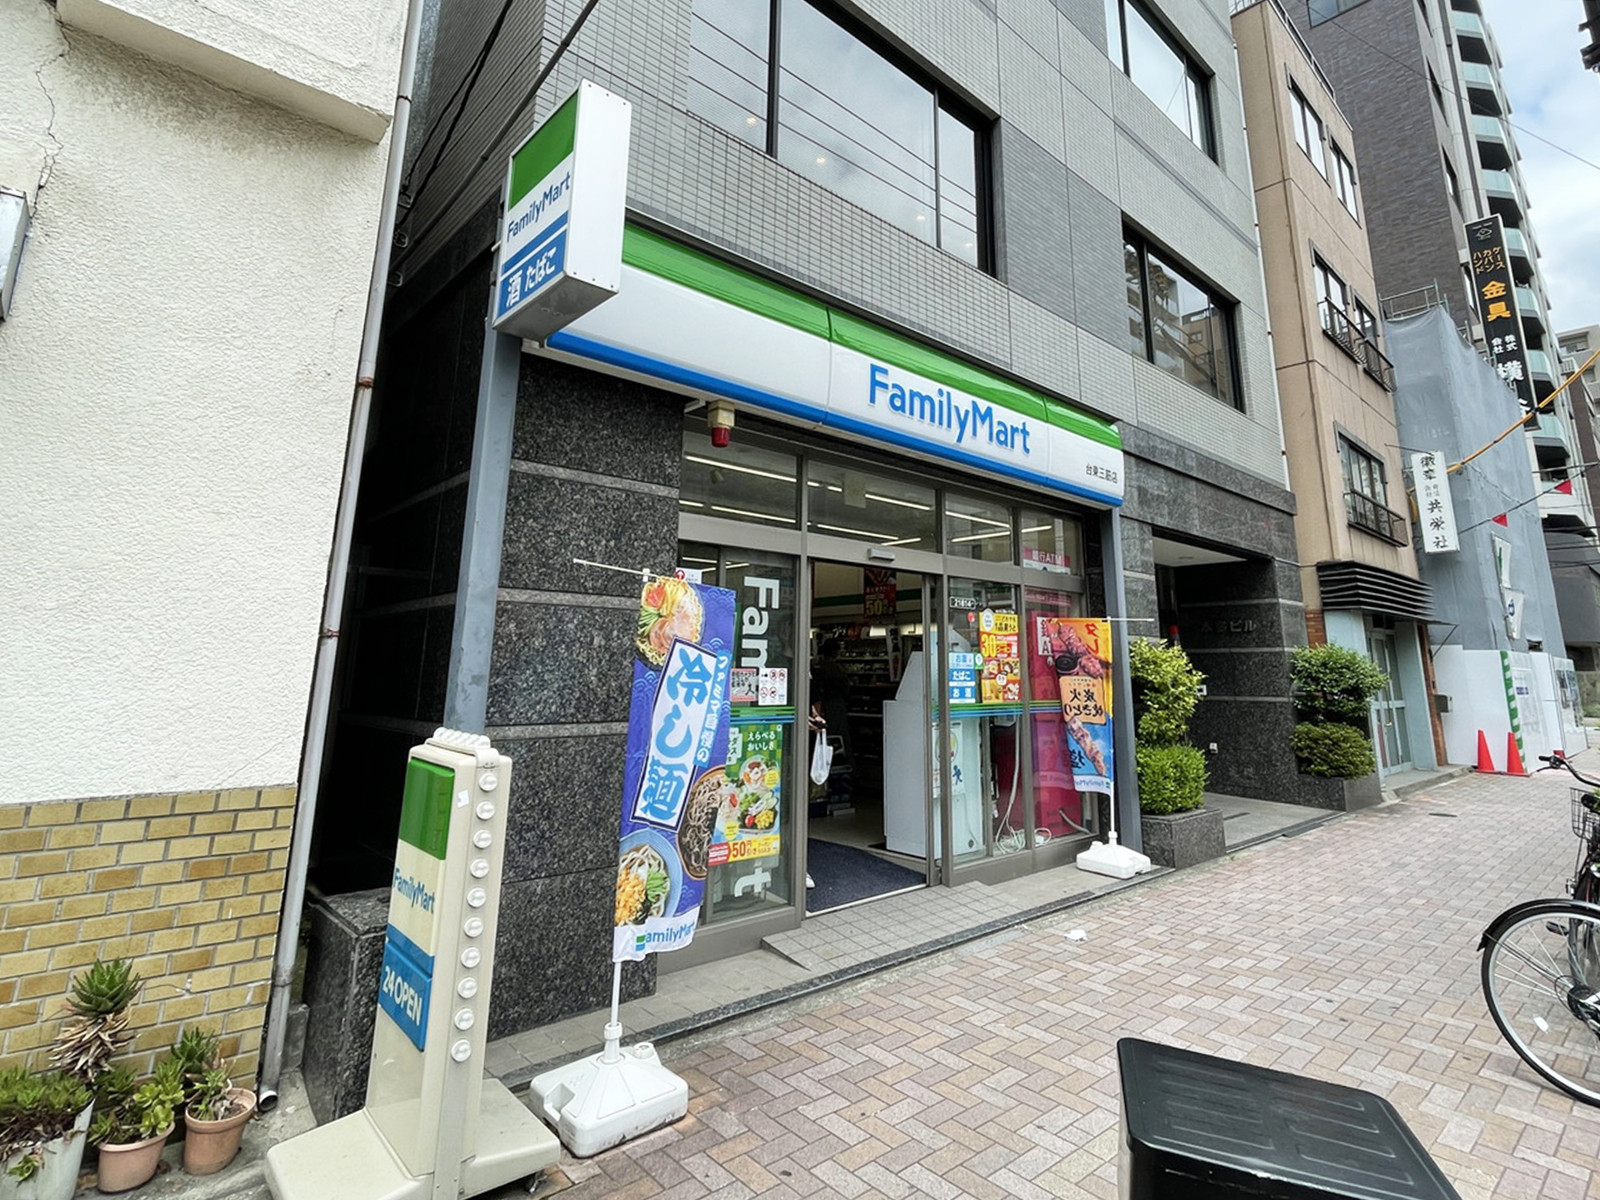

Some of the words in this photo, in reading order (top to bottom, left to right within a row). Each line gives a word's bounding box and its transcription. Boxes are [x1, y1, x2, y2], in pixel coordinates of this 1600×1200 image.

[507, 171, 570, 242] FamilyMart
[507, 270, 523, 307] 酒
[525, 246, 557, 292] たばこ
[1483, 249, 1495, 272] カバン
[1482, 280, 1511, 322] 金具
[869, 363, 1030, 455] FamilyMart
[952, 670, 972, 681] たばこ
[392, 867, 436, 916] FamilyMart
